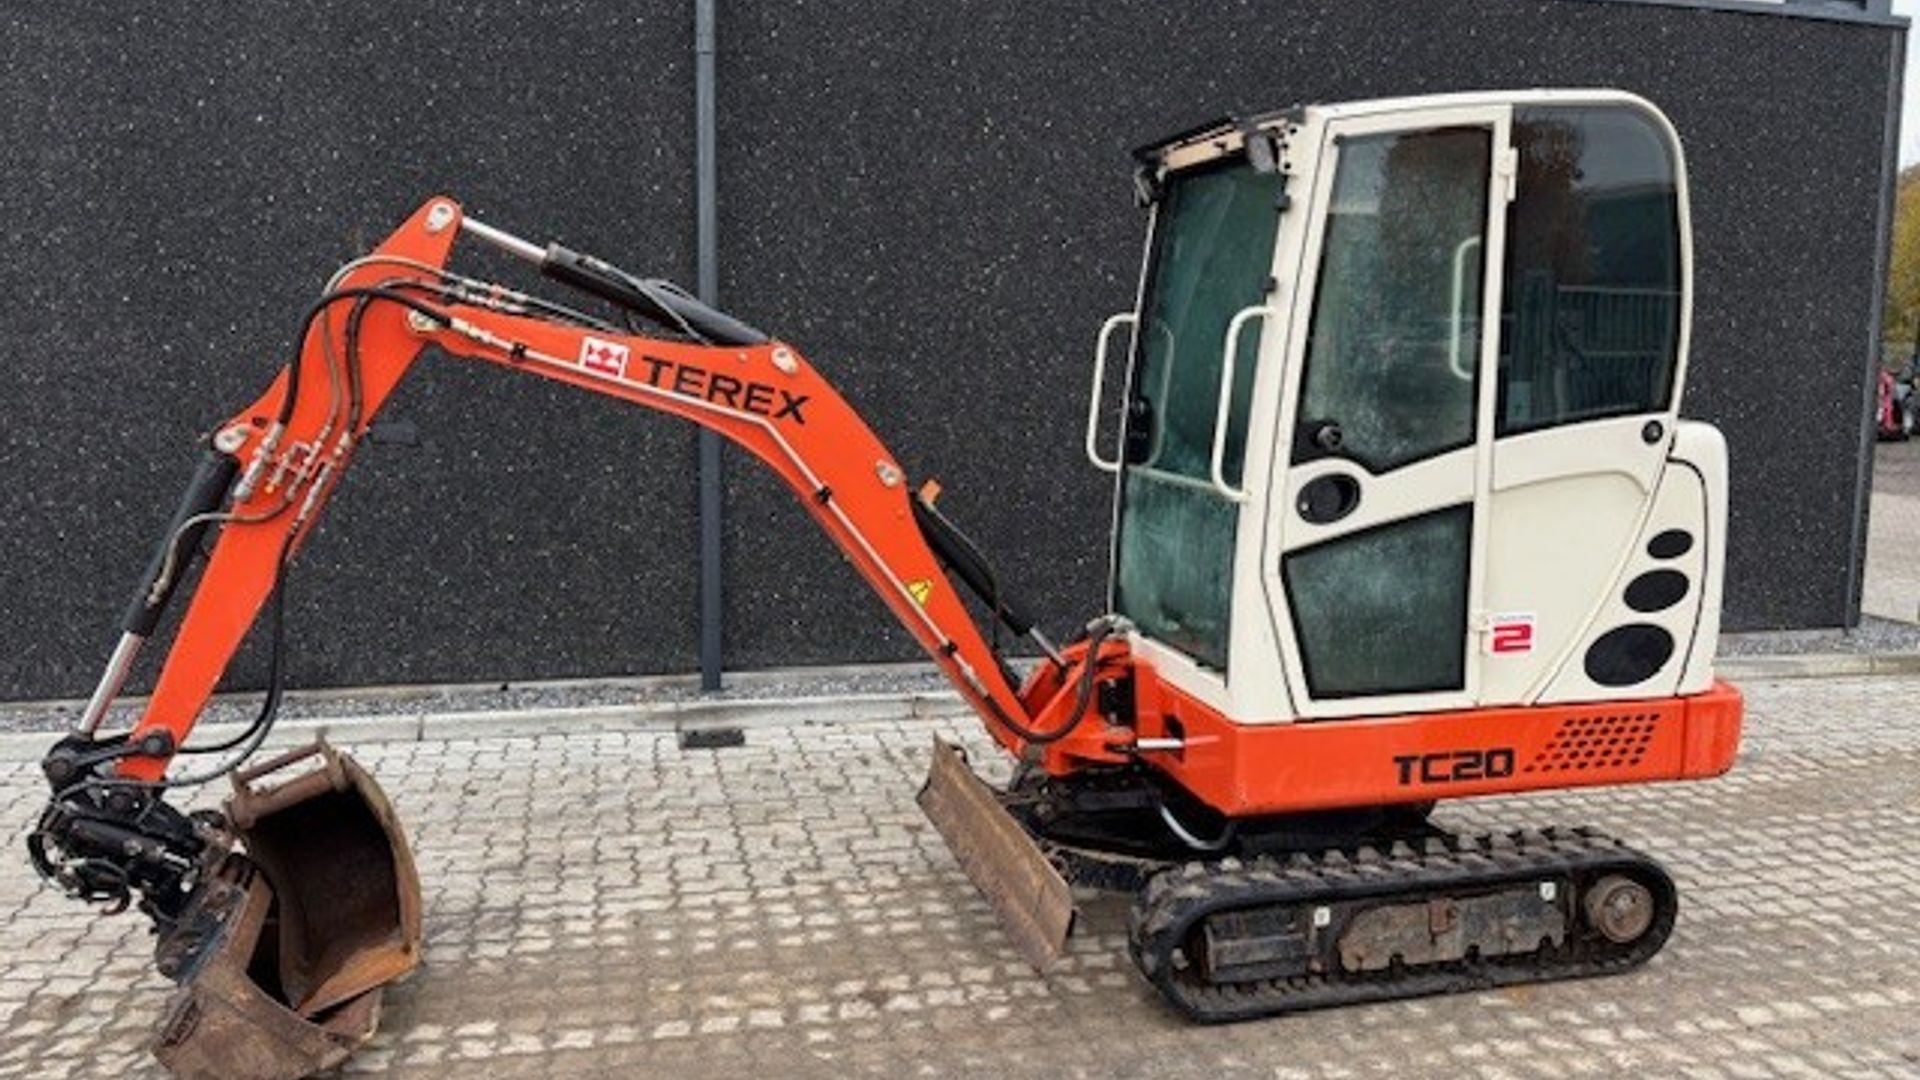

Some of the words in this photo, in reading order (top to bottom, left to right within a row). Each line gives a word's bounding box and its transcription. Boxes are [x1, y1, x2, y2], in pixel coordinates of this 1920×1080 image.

[642, 356, 809, 424] TEREX
[1493, 623, 1532, 653] 2
[1393, 748, 1515, 785] TC20
